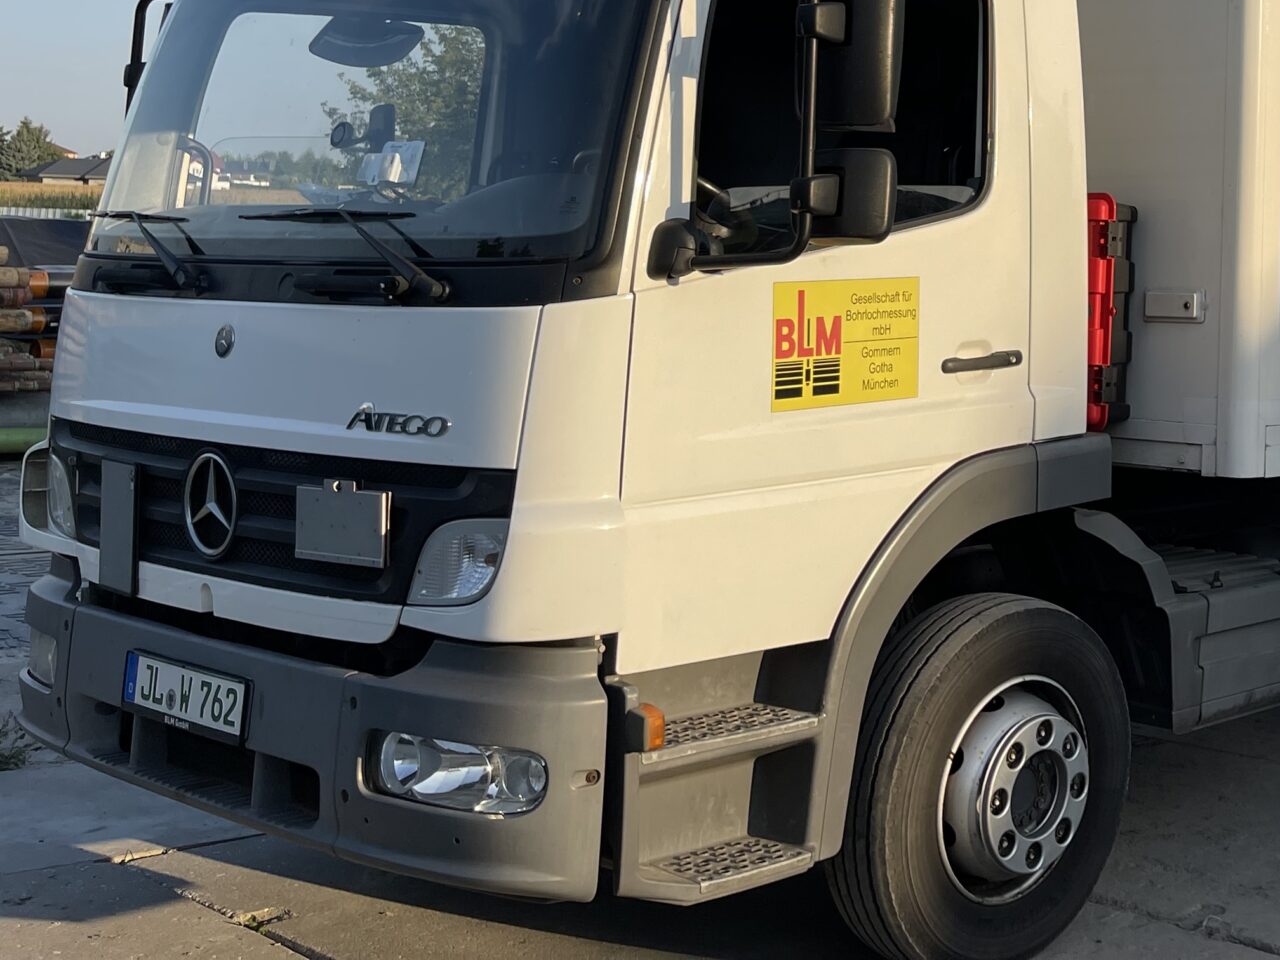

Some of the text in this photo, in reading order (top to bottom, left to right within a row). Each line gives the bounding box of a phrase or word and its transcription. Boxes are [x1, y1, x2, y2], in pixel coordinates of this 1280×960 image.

[851, 291, 913, 305] Gesellschaft für
[845, 308, 917, 322] Bohrlochmessung
[775, 290, 842, 359] BLM
[872, 324, 891, 336] mbH
[861, 346, 901, 358] Gommern
[869, 362, 893, 374] Gotha
[862, 378, 899, 390] München
[141, 664, 238, 728] JL W 762
